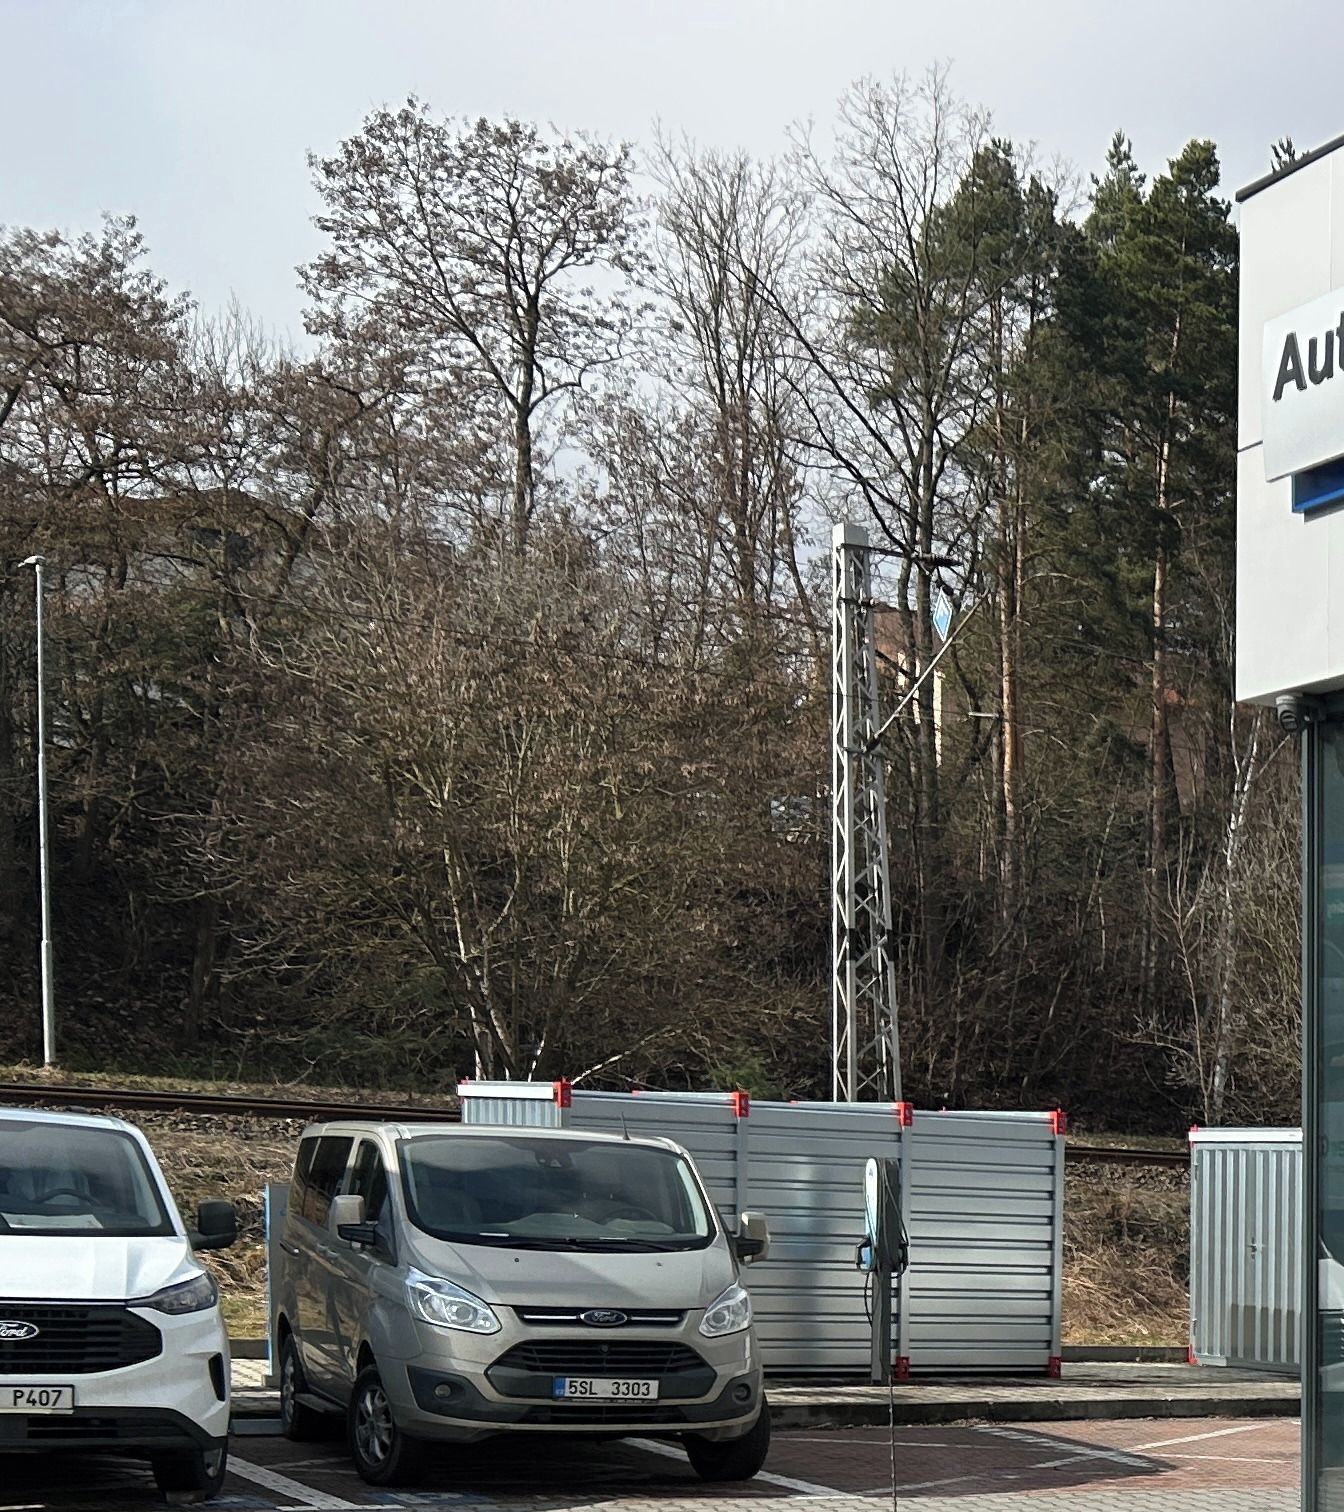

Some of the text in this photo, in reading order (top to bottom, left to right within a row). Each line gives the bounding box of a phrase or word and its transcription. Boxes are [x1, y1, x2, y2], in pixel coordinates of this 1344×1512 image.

[568, 1380, 598, 1396] 5SL
[611, 1382, 651, 1397] 3303
[13, 1389, 62, 1407] P407
